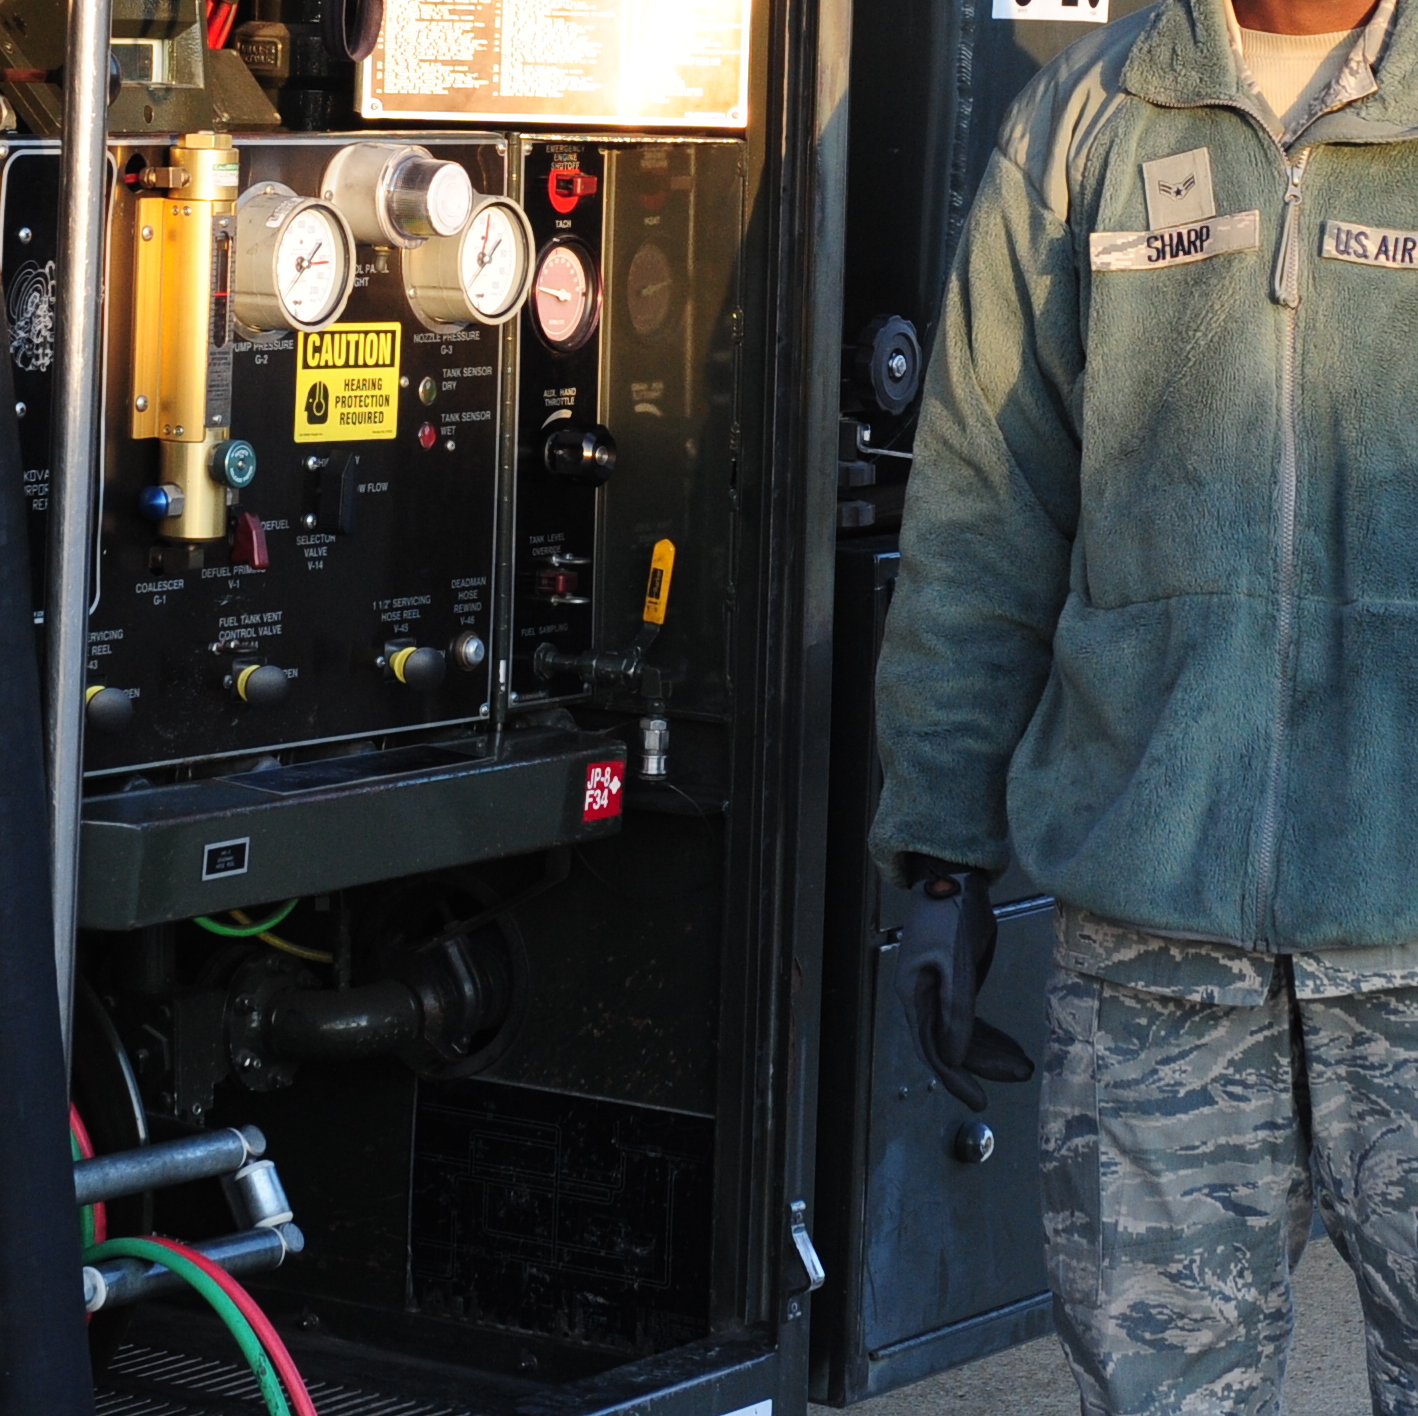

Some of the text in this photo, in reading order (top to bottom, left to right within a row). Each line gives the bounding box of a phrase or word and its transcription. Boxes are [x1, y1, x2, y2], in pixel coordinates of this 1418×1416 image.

[553, 153, 578, 162] ENGINE
[550, 161, 580, 171] SHUTOFF
[555, 219, 572, 229] TACH
[1146, 225, 1211, 263] SHARP
[1374, 234, 1416, 264] AIR
[413, 330, 480, 344] NOZZLE PRESSURE
[306, 332, 392, 368] CAUTION
[440, 345, 454, 355] G-3
[254, 354, 269, 365] G-2
[442, 366, 493, 378] TANK SENSOR
[343, 379, 383, 392] HEARING
[442, 380, 457, 391] DRY
[559, 387, 577, 397] HAND
[334, 394, 390, 409] PROTECTION
[544, 396, 575, 407] THROTTLE
[339, 411, 384, 426] REQUIRED
[441, 410, 491, 423] TANK SENSOR
[440, 424, 456, 435] WET
[367, 481, 389, 492] FLOW
[261, 519, 290, 531] DEFUEL
[296, 534, 336, 546] SELECTOR
[529, 533, 565, 545] TANK LEVEL
[304, 546, 328, 558] VALVE
[307, 560, 324, 571] V-14
[201, 567, 231, 579] DEFUEL
[135, 579, 185, 594] COALESCER
[228, 579, 240, 589] V-1
[450, 576, 487, 589] DEADMAN
[153, 594, 167, 605] G-1
[457, 590, 479, 600] HOSE
[392, 595, 431, 608] SERVICING
[453, 602, 482, 614] REWIND
[218, 611, 283, 628] FUEL TANK VENT
[381, 608, 421, 622] HOSE REEL
[218, 624, 283, 641] CONTROL VALVE
[520, 627, 536, 637] FUEL
[91, 644, 113, 656] REEL
[586, 766, 612, 789] JP-8
[584, 788, 609, 811] F34
